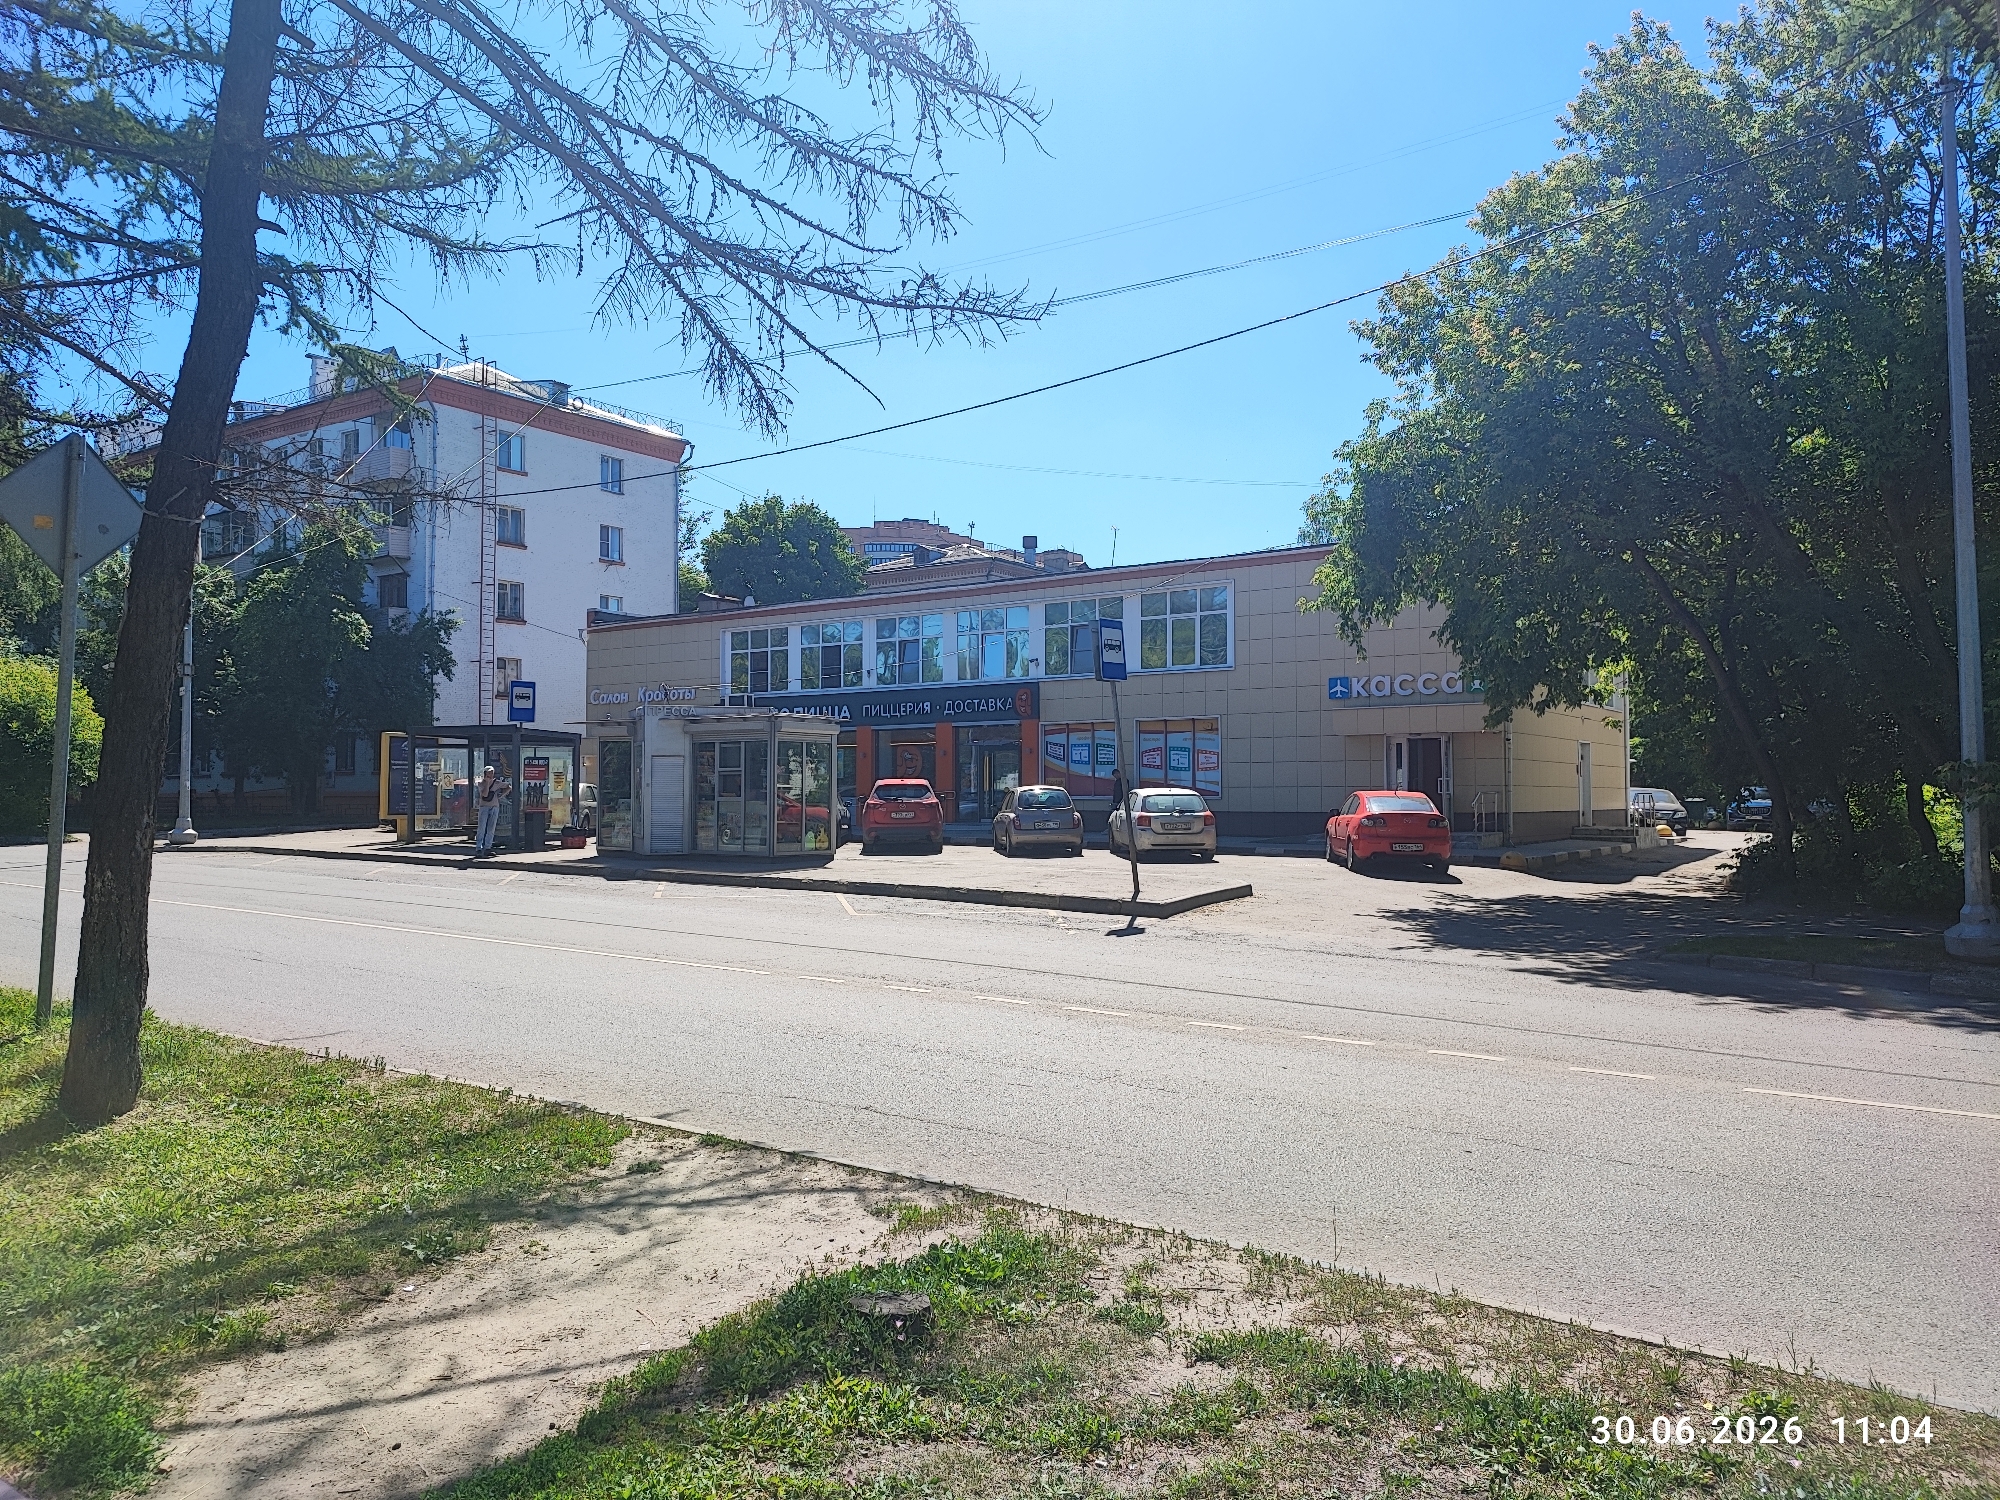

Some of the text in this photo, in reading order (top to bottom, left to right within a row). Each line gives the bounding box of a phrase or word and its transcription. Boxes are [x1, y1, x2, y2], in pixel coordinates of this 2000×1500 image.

[1351, 672, 1464, 698] касса
[590, 689, 629, 704] Салон
[646, 706, 697, 717] ПРЕССА
[862, 702, 931, 718] ПИЦЦЕРИЯ
[943, 697, 1013, 716] ДОСТАВКА
